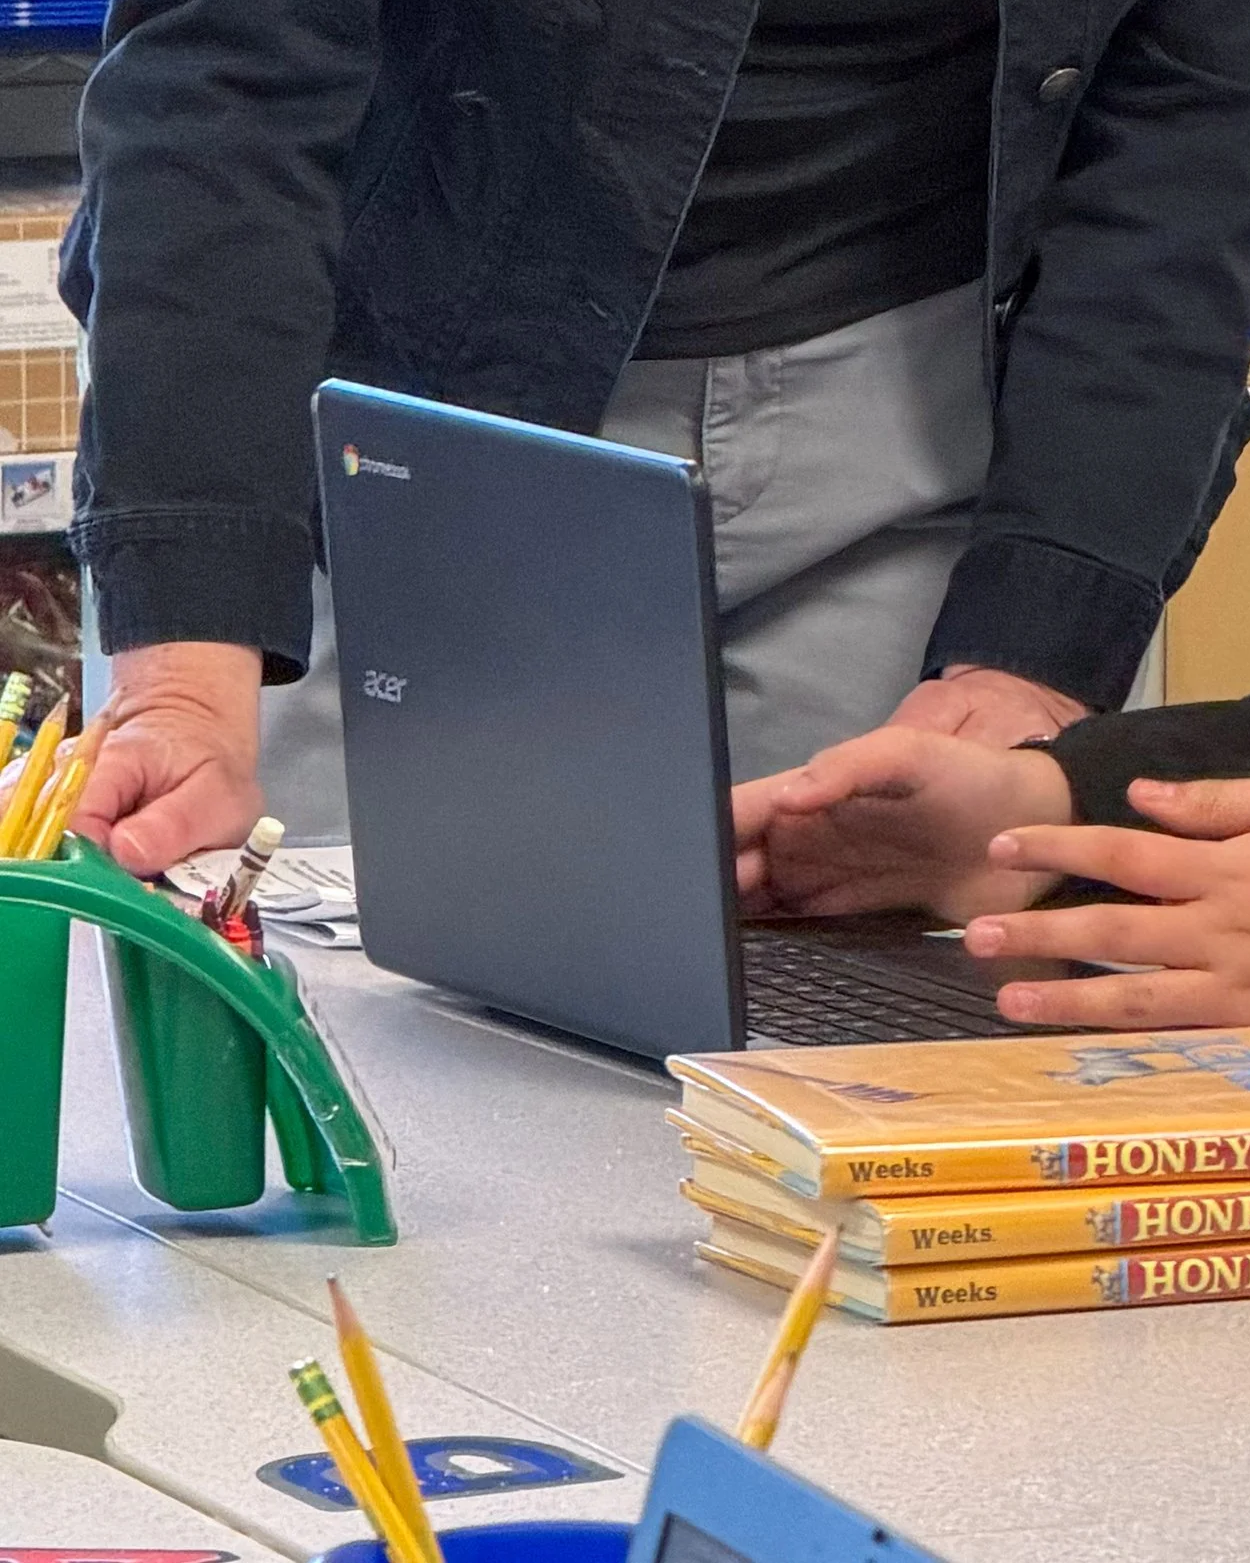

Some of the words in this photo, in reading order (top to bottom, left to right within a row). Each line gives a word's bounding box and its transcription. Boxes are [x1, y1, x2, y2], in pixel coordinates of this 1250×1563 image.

[363, 669, 407, 703] acer
[848, 1157, 935, 1182] Weeks
[911, 1224, 994, 1251] Weeks
[914, 1282, 998, 1308] Weeks
